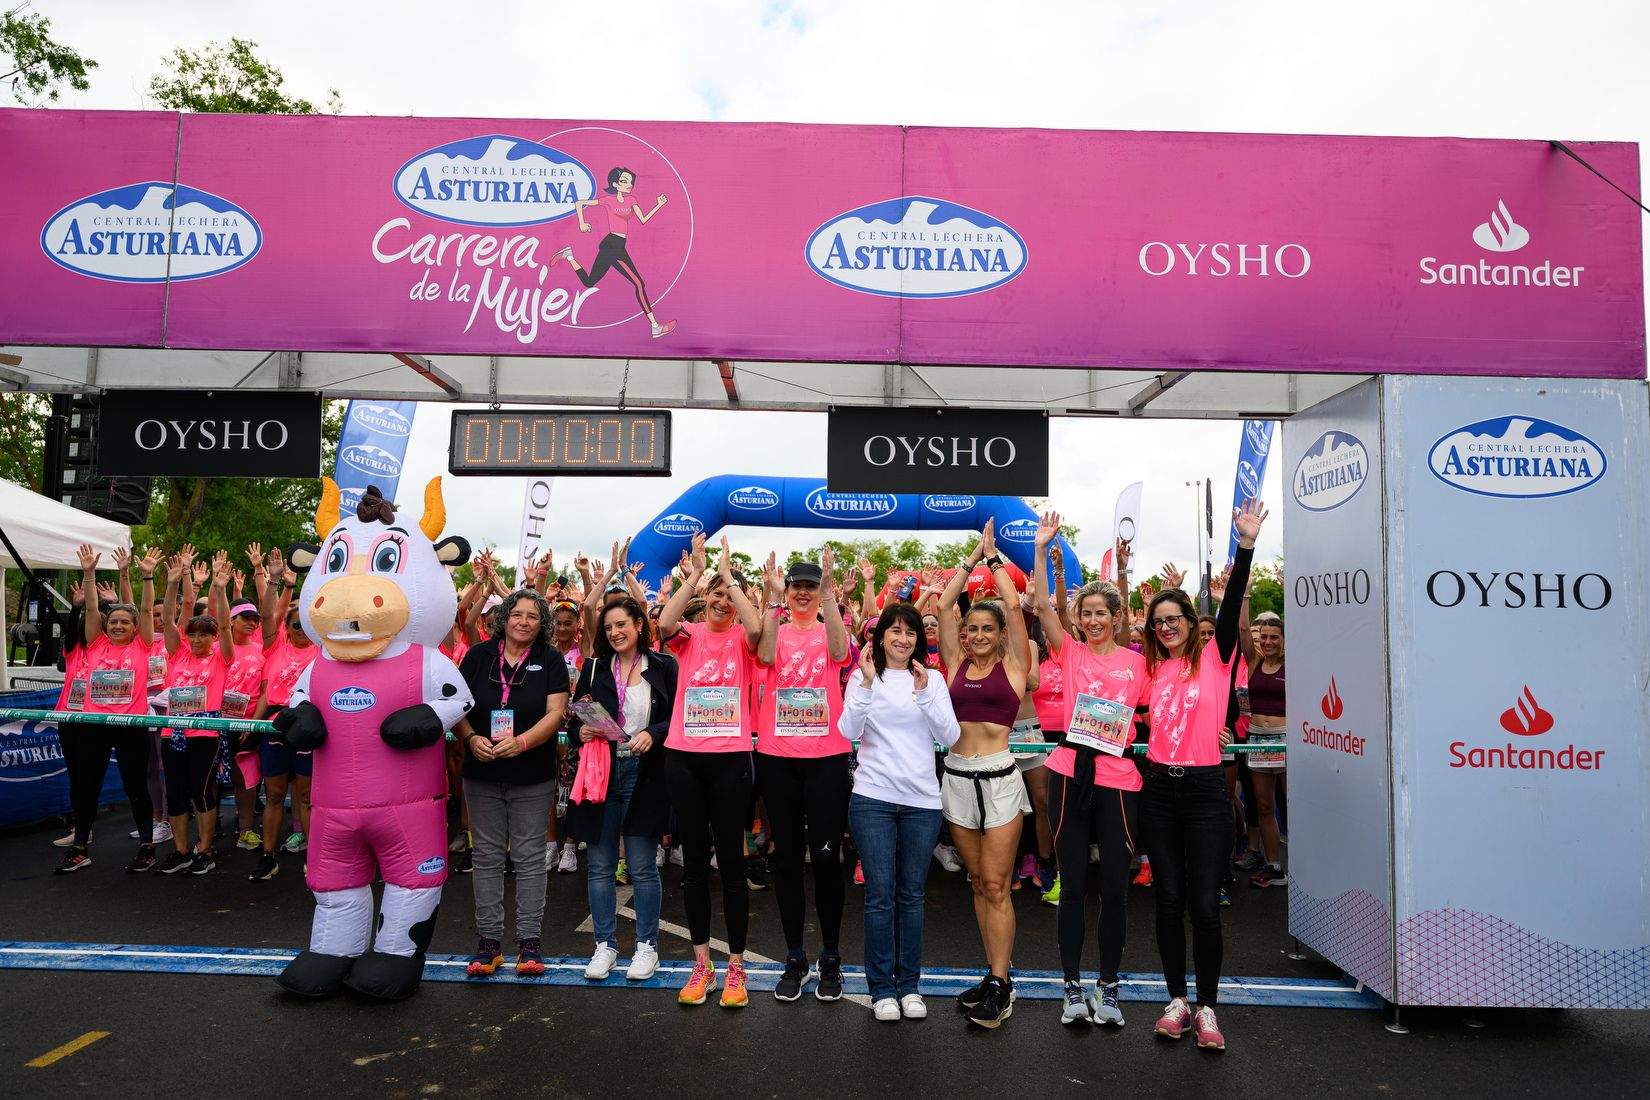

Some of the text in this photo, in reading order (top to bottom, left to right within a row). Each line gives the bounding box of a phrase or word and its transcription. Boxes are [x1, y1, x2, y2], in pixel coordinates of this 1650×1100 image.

[408, 166, 580, 204] ASTURIANA
[441, 165, 575, 177] CENTRAL LECHERA
[57, 218, 244, 256] ASTURIANA
[93, 216, 239, 227] CENTRAL LECHERA
[857, 230, 1004, 243] CENTRAL LECHERA
[372, 217, 539, 269] Carrera
[822, 232, 1011, 273] ASTURIANA
[1138, 241, 1311, 278] OYSHO
[1419, 256, 1585, 287] Santander
[409, 265, 600, 344] de la Mujer
[134, 419, 289, 451] OYSHO
[356, 409, 408, 434] ASTURIANA
[465, 418, 656, 463] 00:00:00
[863, 434, 1017, 468] OYSHO
[1468, 443, 1587, 454] CENTRAL LECHERA
[346, 449, 398, 475] ASTURIANA
[1441, 444, 1594, 479] ASTURIANA
[1298, 460, 1363, 498] ASTURIANA
[732, 493, 775, 505] ASTURIANA
[812, 493, 890, 511] ASTURIANA
[928, 497, 972, 507] ASTURIANA
[657, 521, 700, 533] ASTURIANA
[1004, 527, 1037, 538] ASTURI
[1294, 568, 1371, 608] OYSHO
[1426, 569, 1612, 611] OYSHO
[333, 695, 372, 706] ASTURIANA
[1302, 721, 1366, 757] Santander
[1, 743, 64, 768] STURIA
[1449, 741, 1606, 770] Santander
